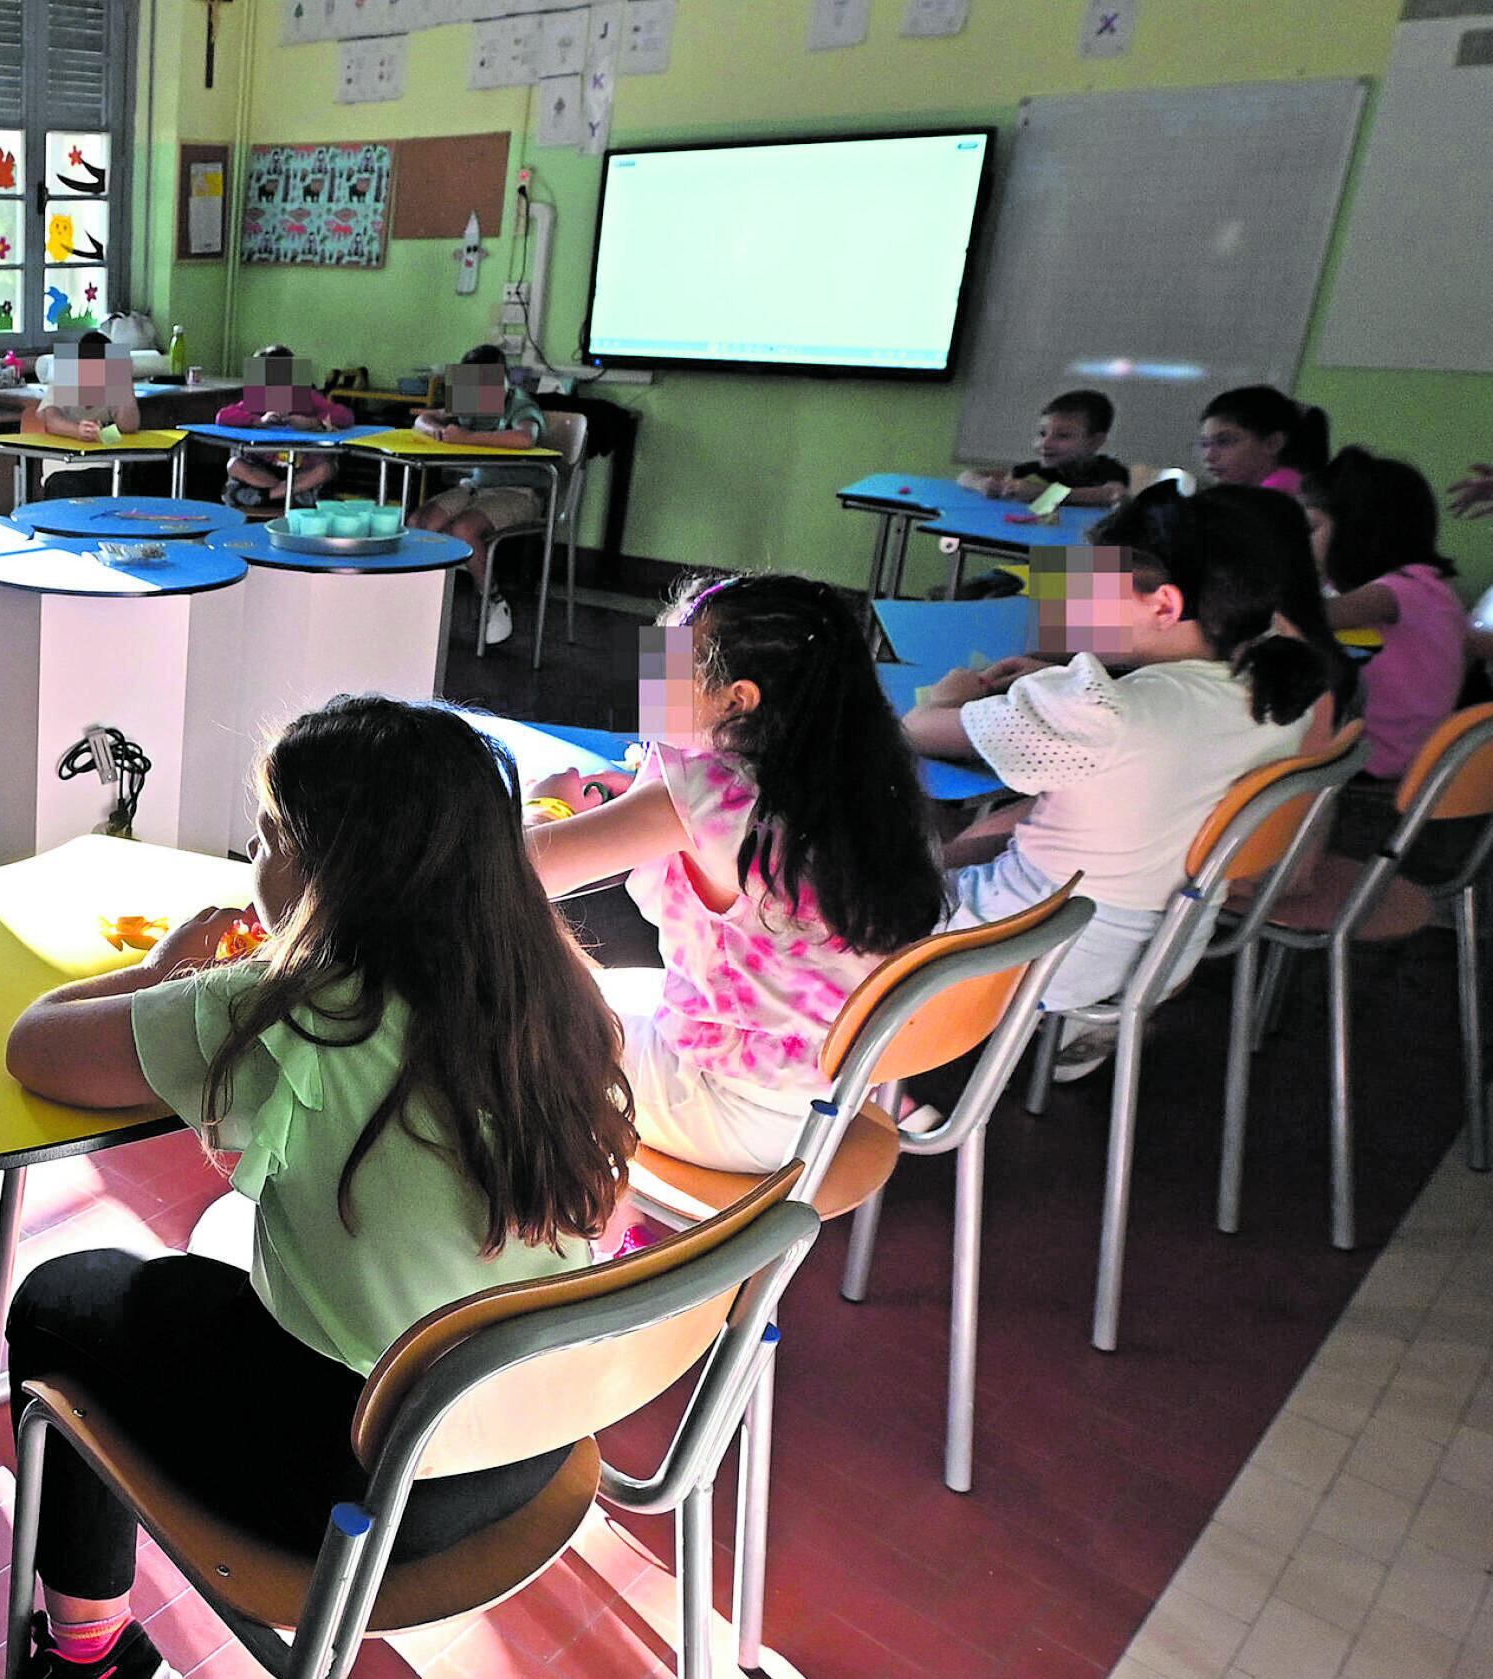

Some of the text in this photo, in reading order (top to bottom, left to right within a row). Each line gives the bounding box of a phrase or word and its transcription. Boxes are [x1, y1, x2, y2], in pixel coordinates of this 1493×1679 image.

[600, 22, 609, 39] J
[593, 73, 604, 89] K
[588, 122, 600, 137] Y
